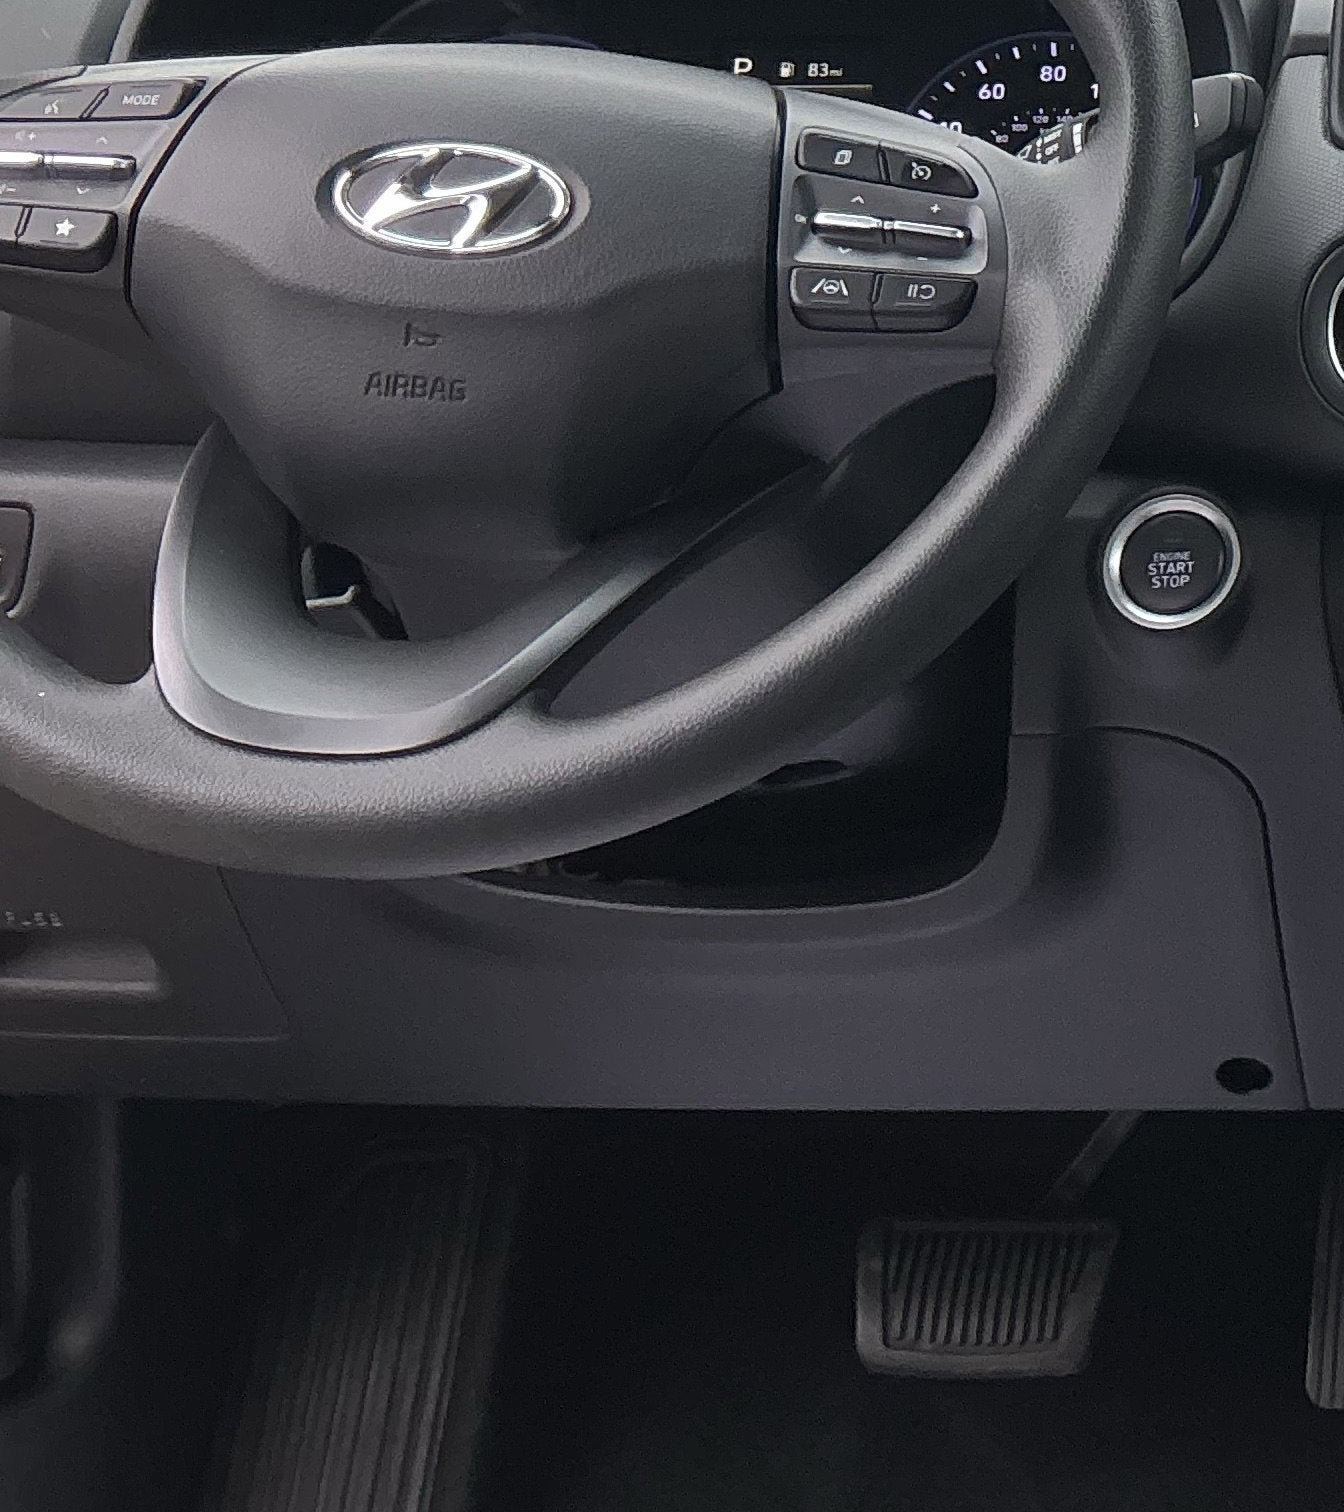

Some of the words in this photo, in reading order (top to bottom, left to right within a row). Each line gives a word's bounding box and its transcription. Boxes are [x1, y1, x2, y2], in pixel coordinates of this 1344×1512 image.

[734, 57, 753, 75] P
[1040, 65, 1067, 82] 80
[978, 83, 1005, 100] 60
[122, 94, 161, 106] MODE
[364, 371, 467, 401] AIRBAG
[1152, 551, 1191, 562] ENGINE
[1147, 561, 1195, 576] START
[1151, 575, 1191, 589] STOP
